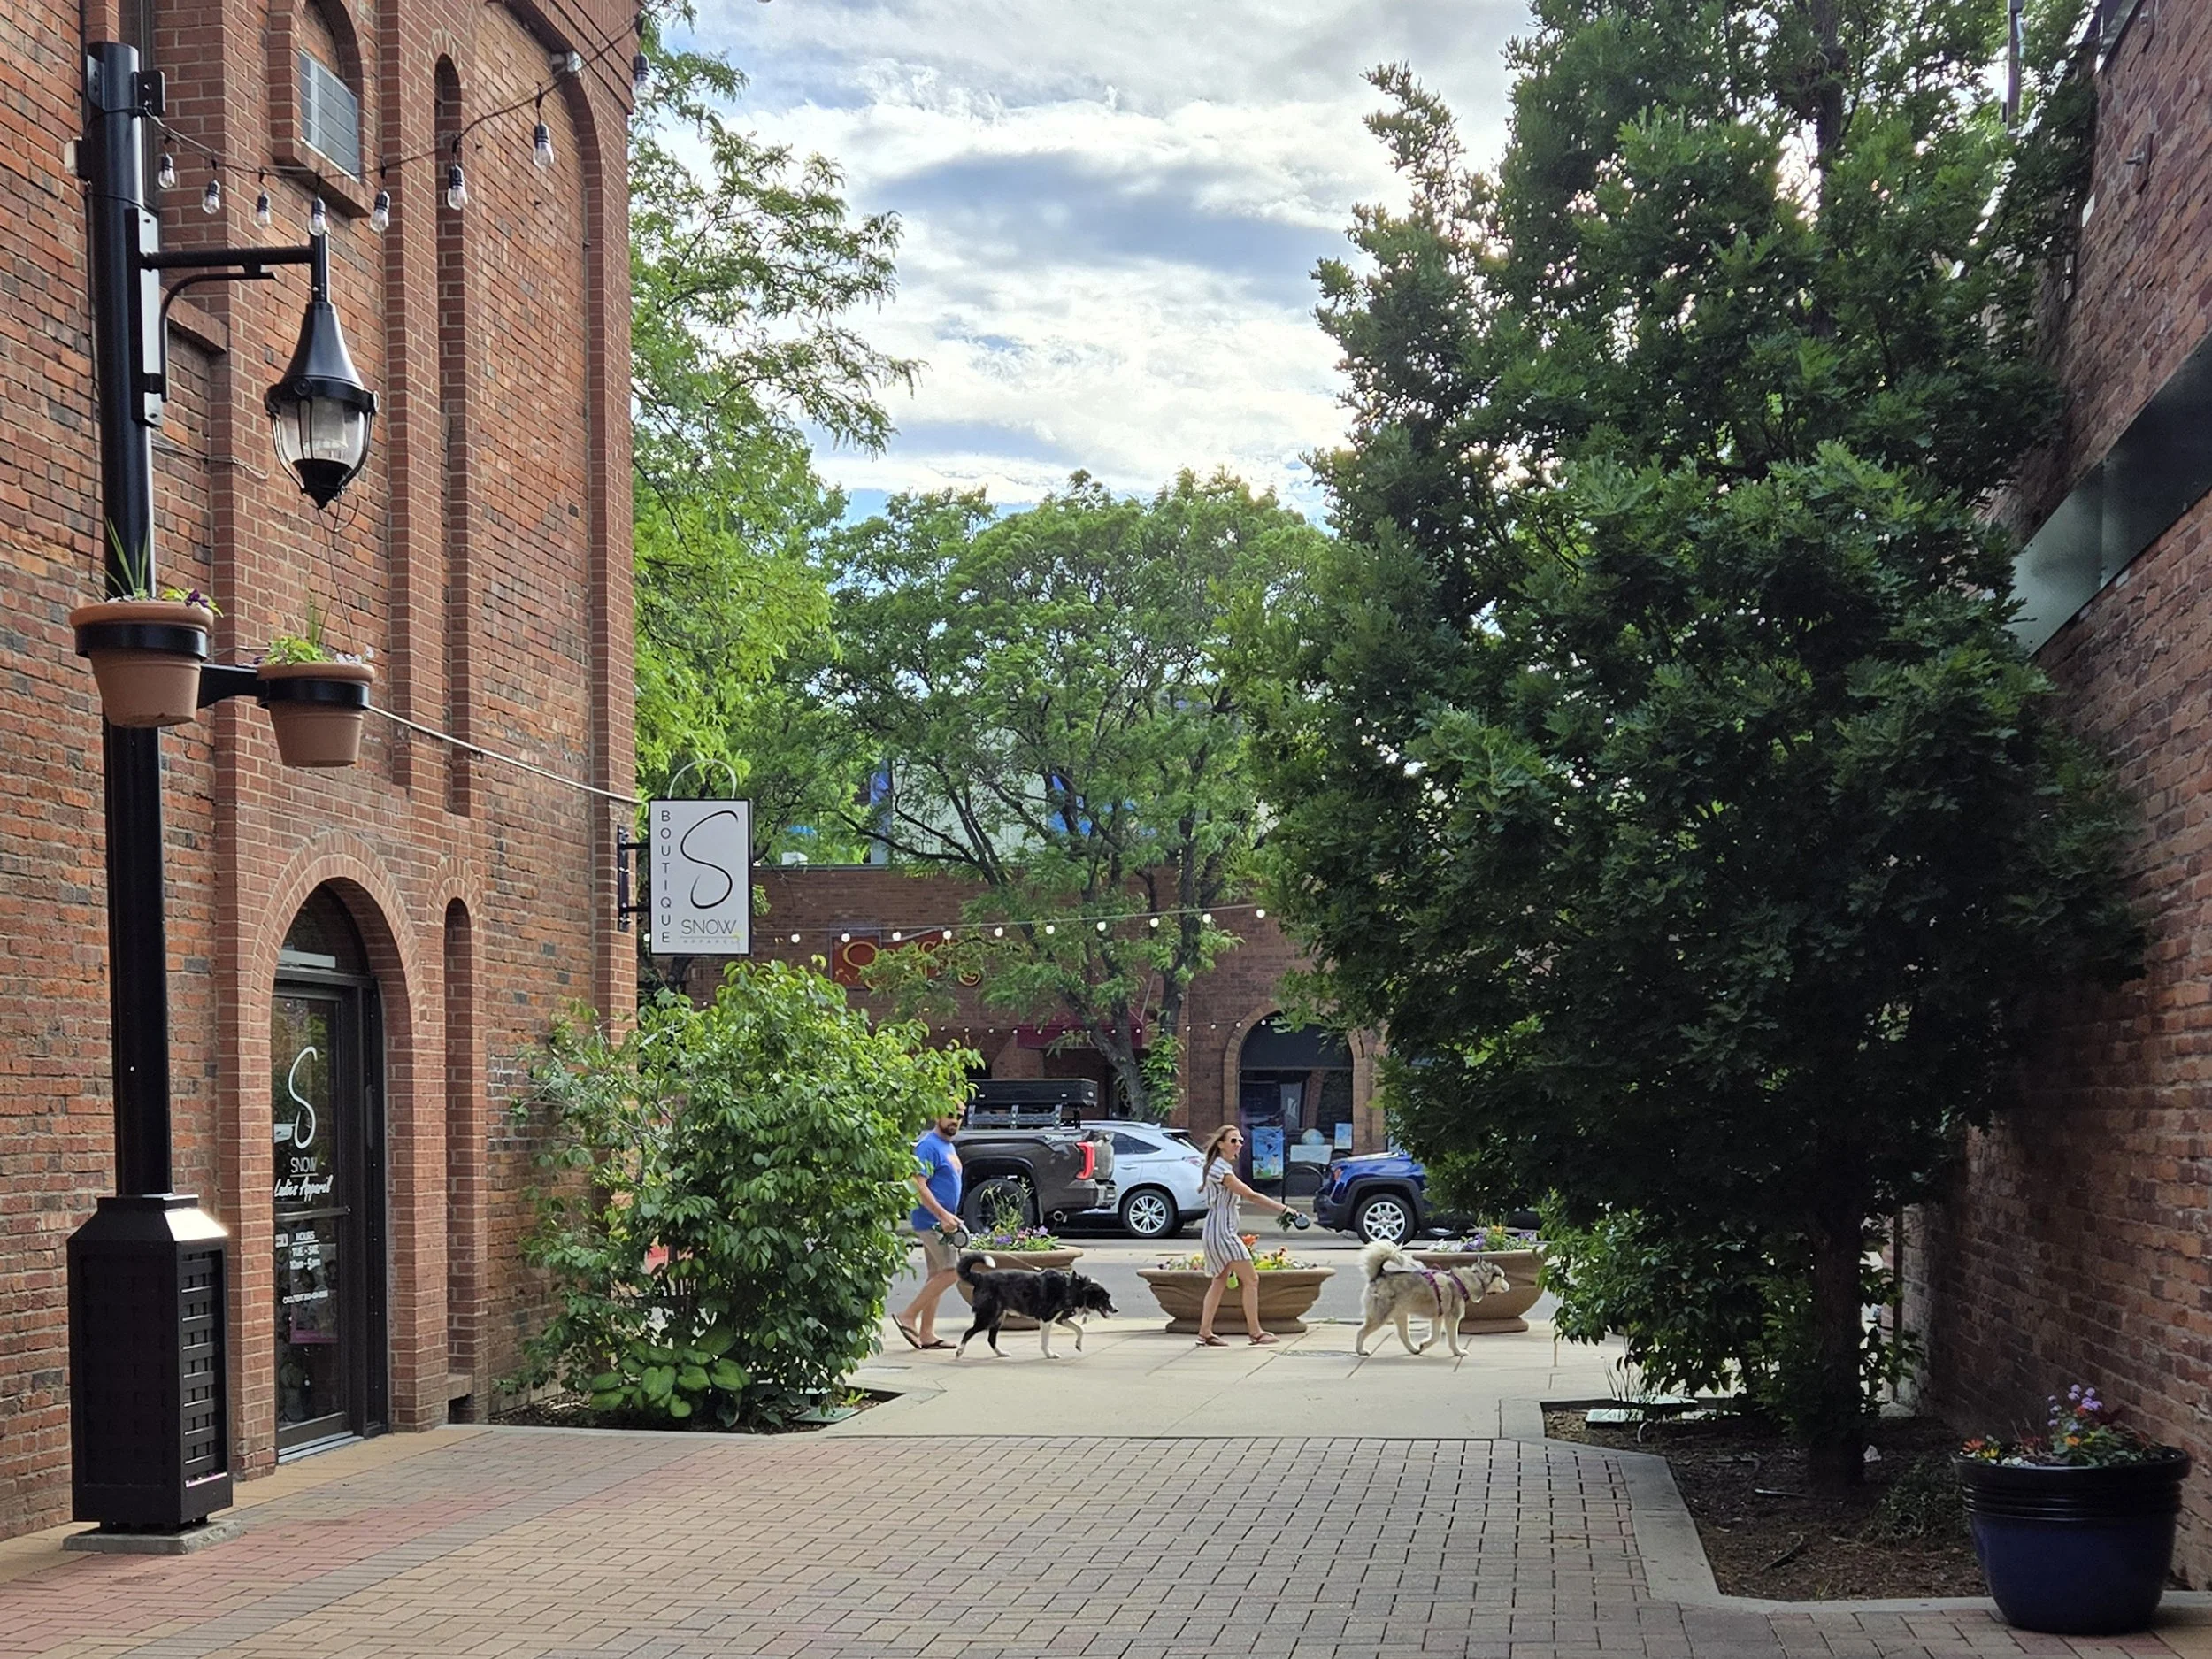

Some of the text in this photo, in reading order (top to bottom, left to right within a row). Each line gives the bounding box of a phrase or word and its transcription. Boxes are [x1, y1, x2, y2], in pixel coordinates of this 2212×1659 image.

[660, 810, 672, 943] BOUTIQUE
[680, 918, 737, 935] SNOW
[290, 1156, 318, 1173] SNOW
[295, 1230, 316, 1241] HOURS
